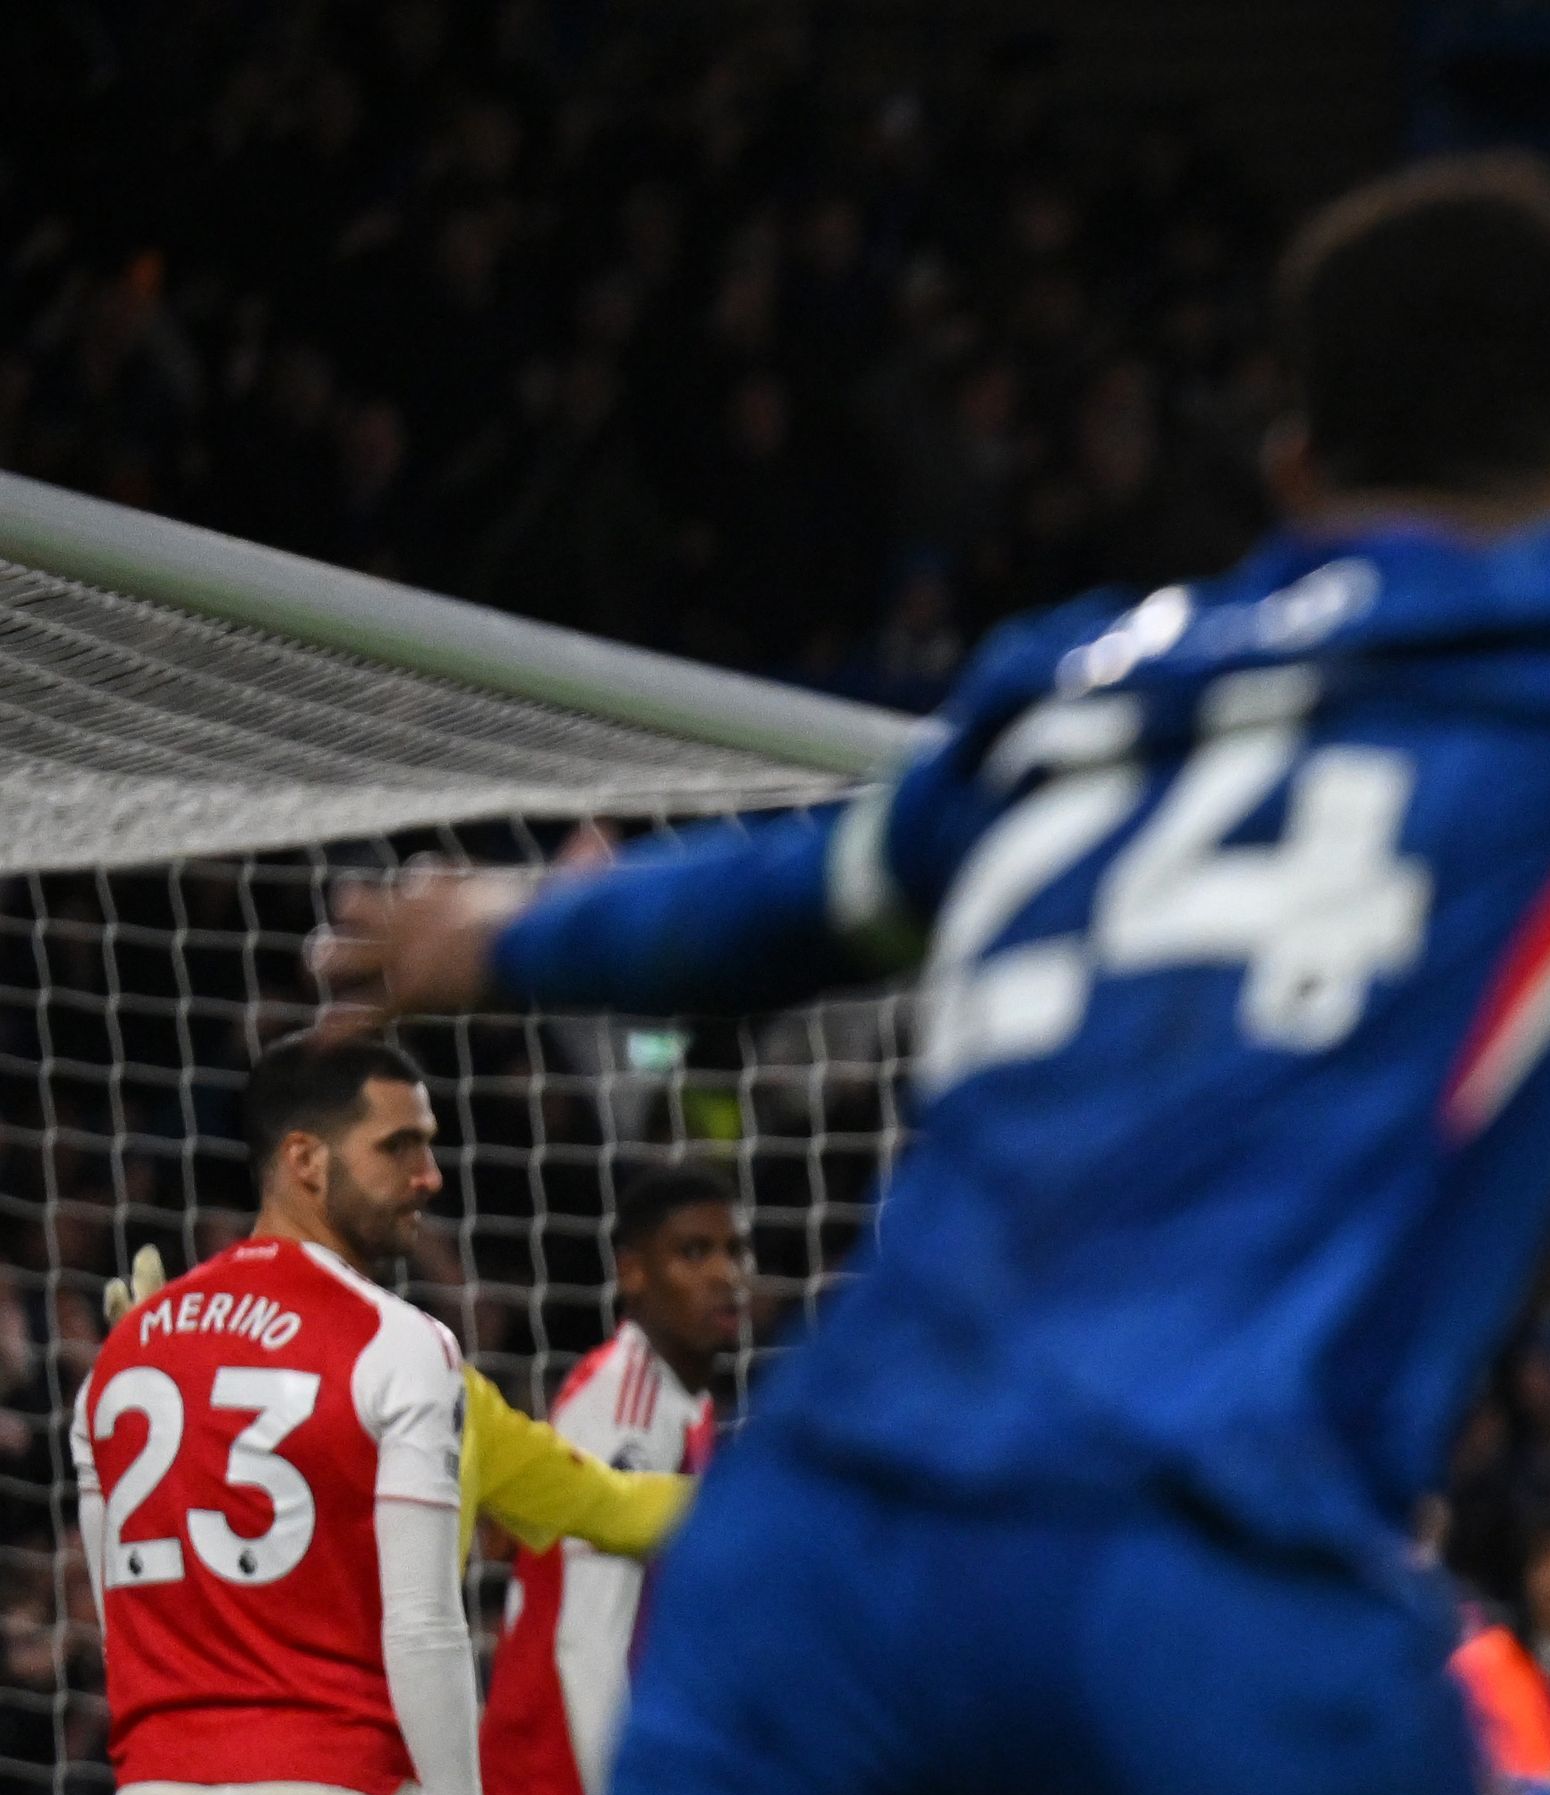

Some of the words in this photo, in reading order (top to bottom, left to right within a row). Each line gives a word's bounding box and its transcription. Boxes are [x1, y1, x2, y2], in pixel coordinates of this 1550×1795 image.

[912, 662, 1434, 1102] 24
[139, 1292, 302, 1350] MERINO
[93, 1366, 322, 1590] 23
